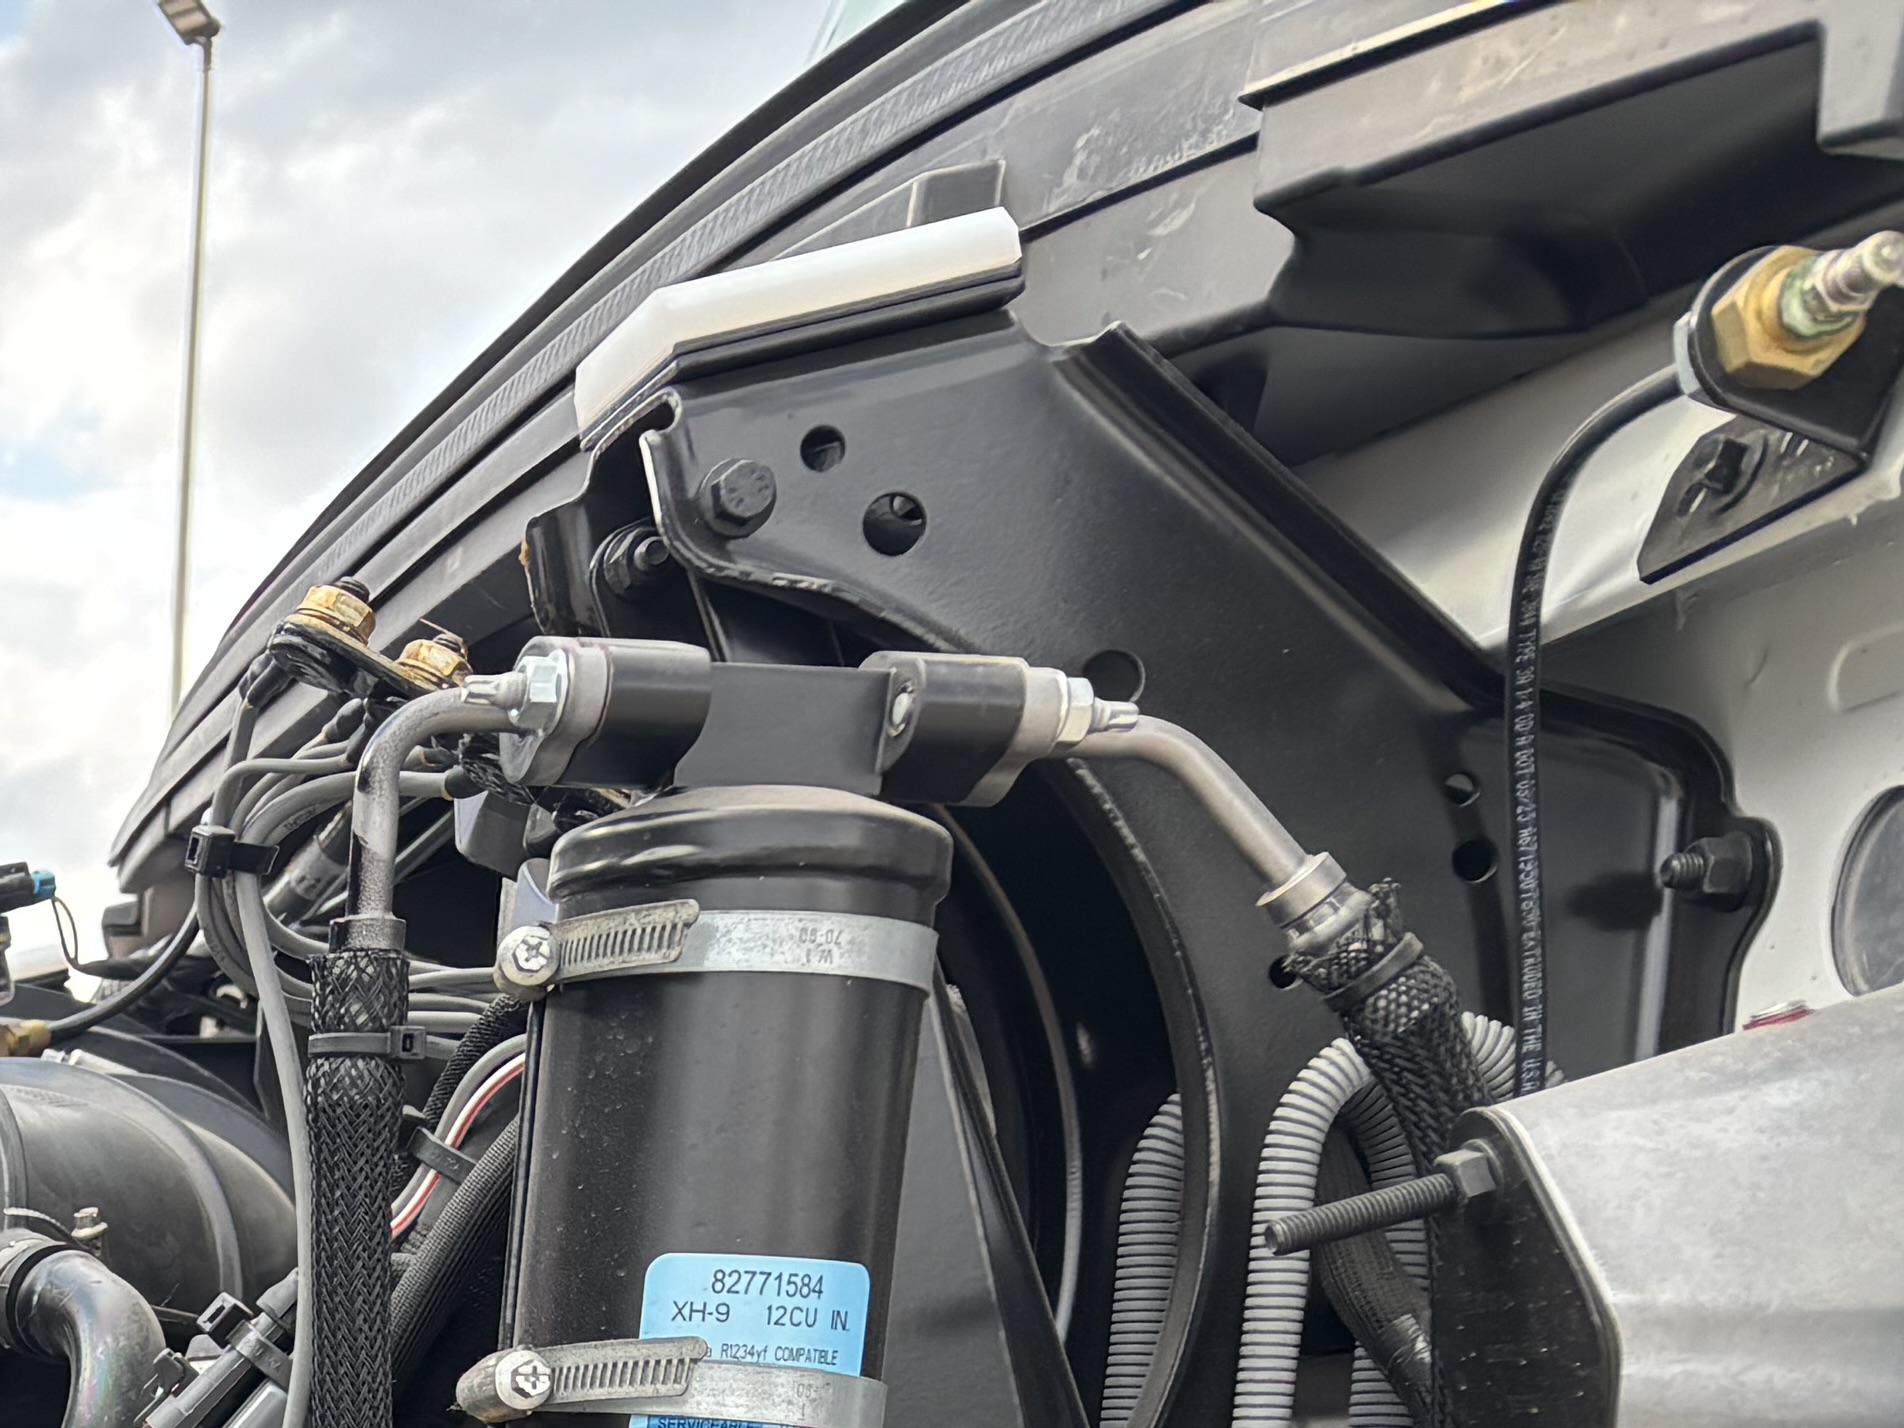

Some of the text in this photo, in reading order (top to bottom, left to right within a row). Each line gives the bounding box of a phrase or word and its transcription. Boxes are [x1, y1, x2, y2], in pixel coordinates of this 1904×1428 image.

[711, 1269, 824, 1299] 82771584
[671, 1301, 731, 1323] XH-9
[766, 1304, 818, 1328] 12CU
[774, 1346, 839, 1367] COMPATIBLE
